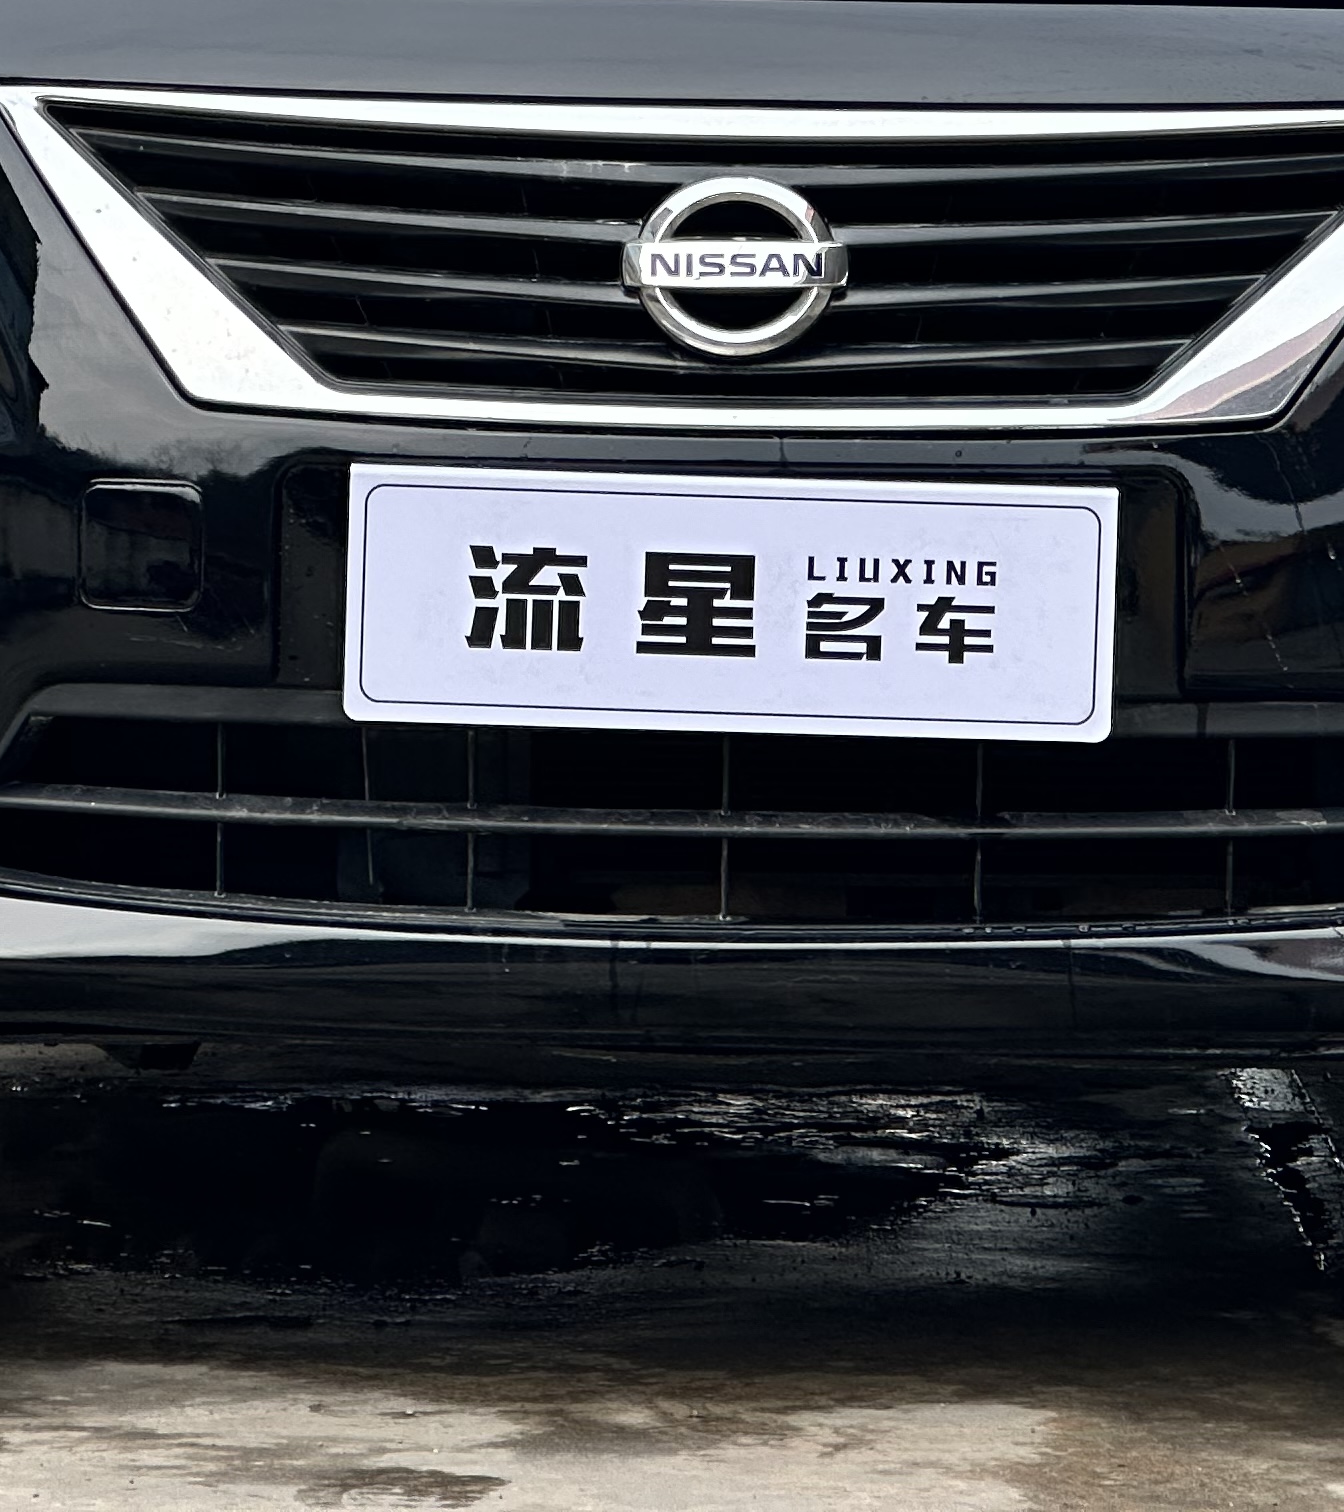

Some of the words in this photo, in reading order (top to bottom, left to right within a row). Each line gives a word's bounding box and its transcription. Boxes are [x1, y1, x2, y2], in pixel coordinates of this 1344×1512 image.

[650, 253, 823, 278] NISSAN
[807, 555, 997, 587] LIUXING
[464, 544, 756, 658] 流星
[804, 592, 996, 664] 名车
